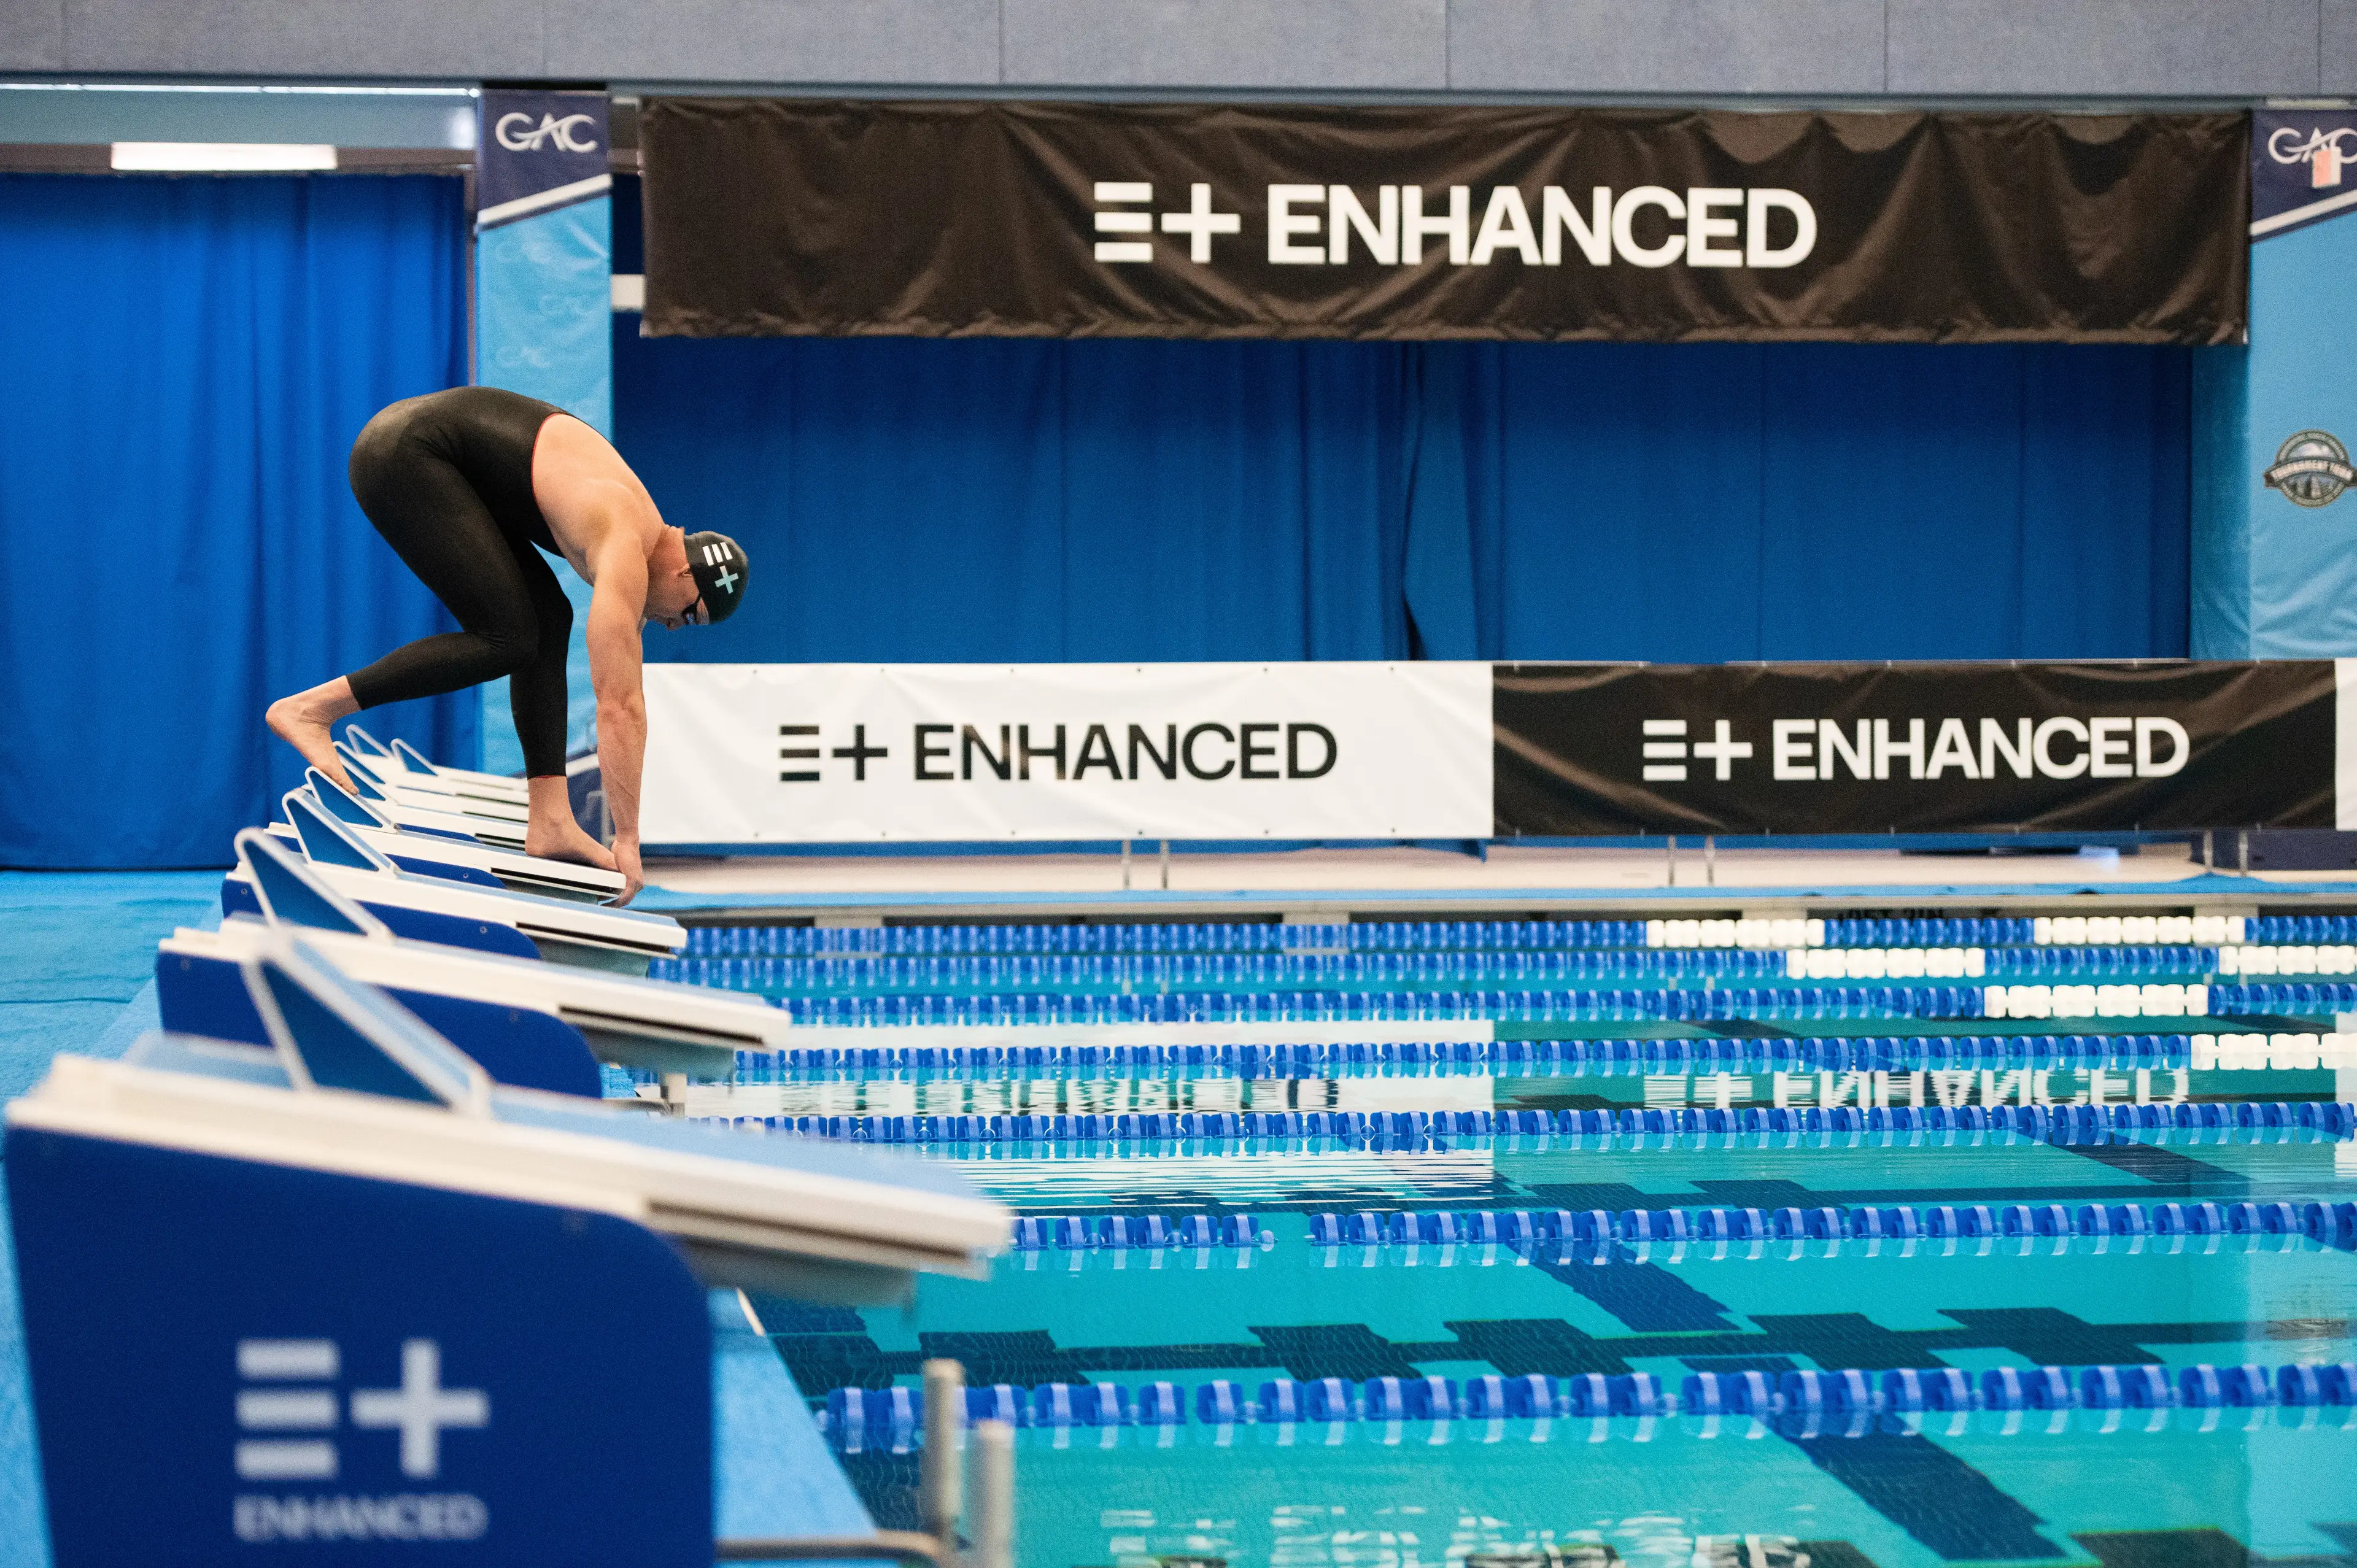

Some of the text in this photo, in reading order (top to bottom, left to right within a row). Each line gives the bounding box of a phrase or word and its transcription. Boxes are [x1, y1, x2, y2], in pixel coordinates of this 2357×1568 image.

[495, 112, 598, 153] GAC
[1267, 183, 1817, 268] ENHANCED
[915, 723, 1337, 781] ENHANCED
[1773, 717, 2190, 780] ENHANCED
